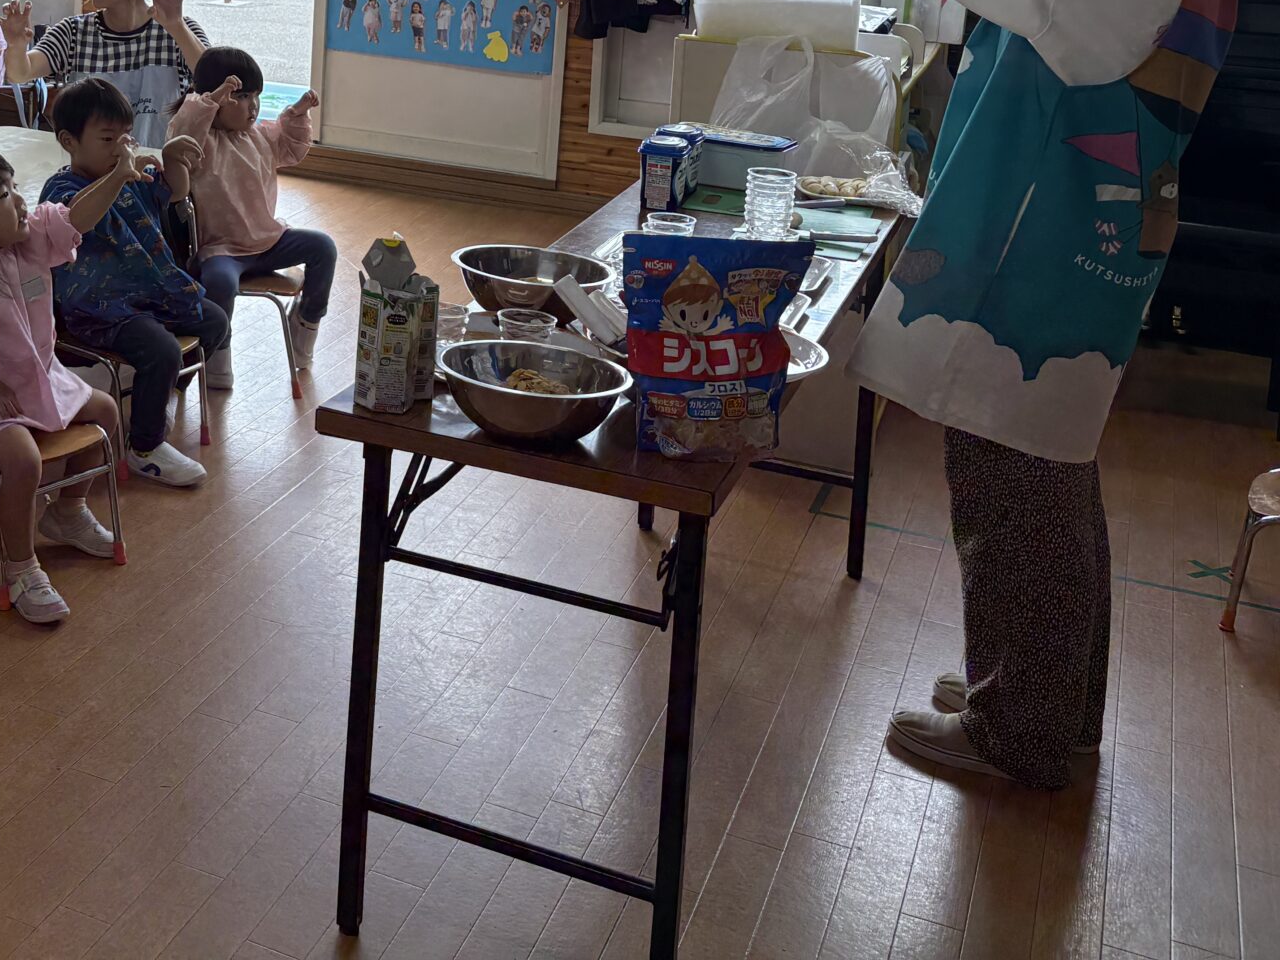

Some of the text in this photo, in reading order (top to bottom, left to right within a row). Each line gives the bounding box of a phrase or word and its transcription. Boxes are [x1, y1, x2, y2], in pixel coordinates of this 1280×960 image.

[644, 259, 673, 271] NISSIN
[663, 337, 763, 376] シスコーン
